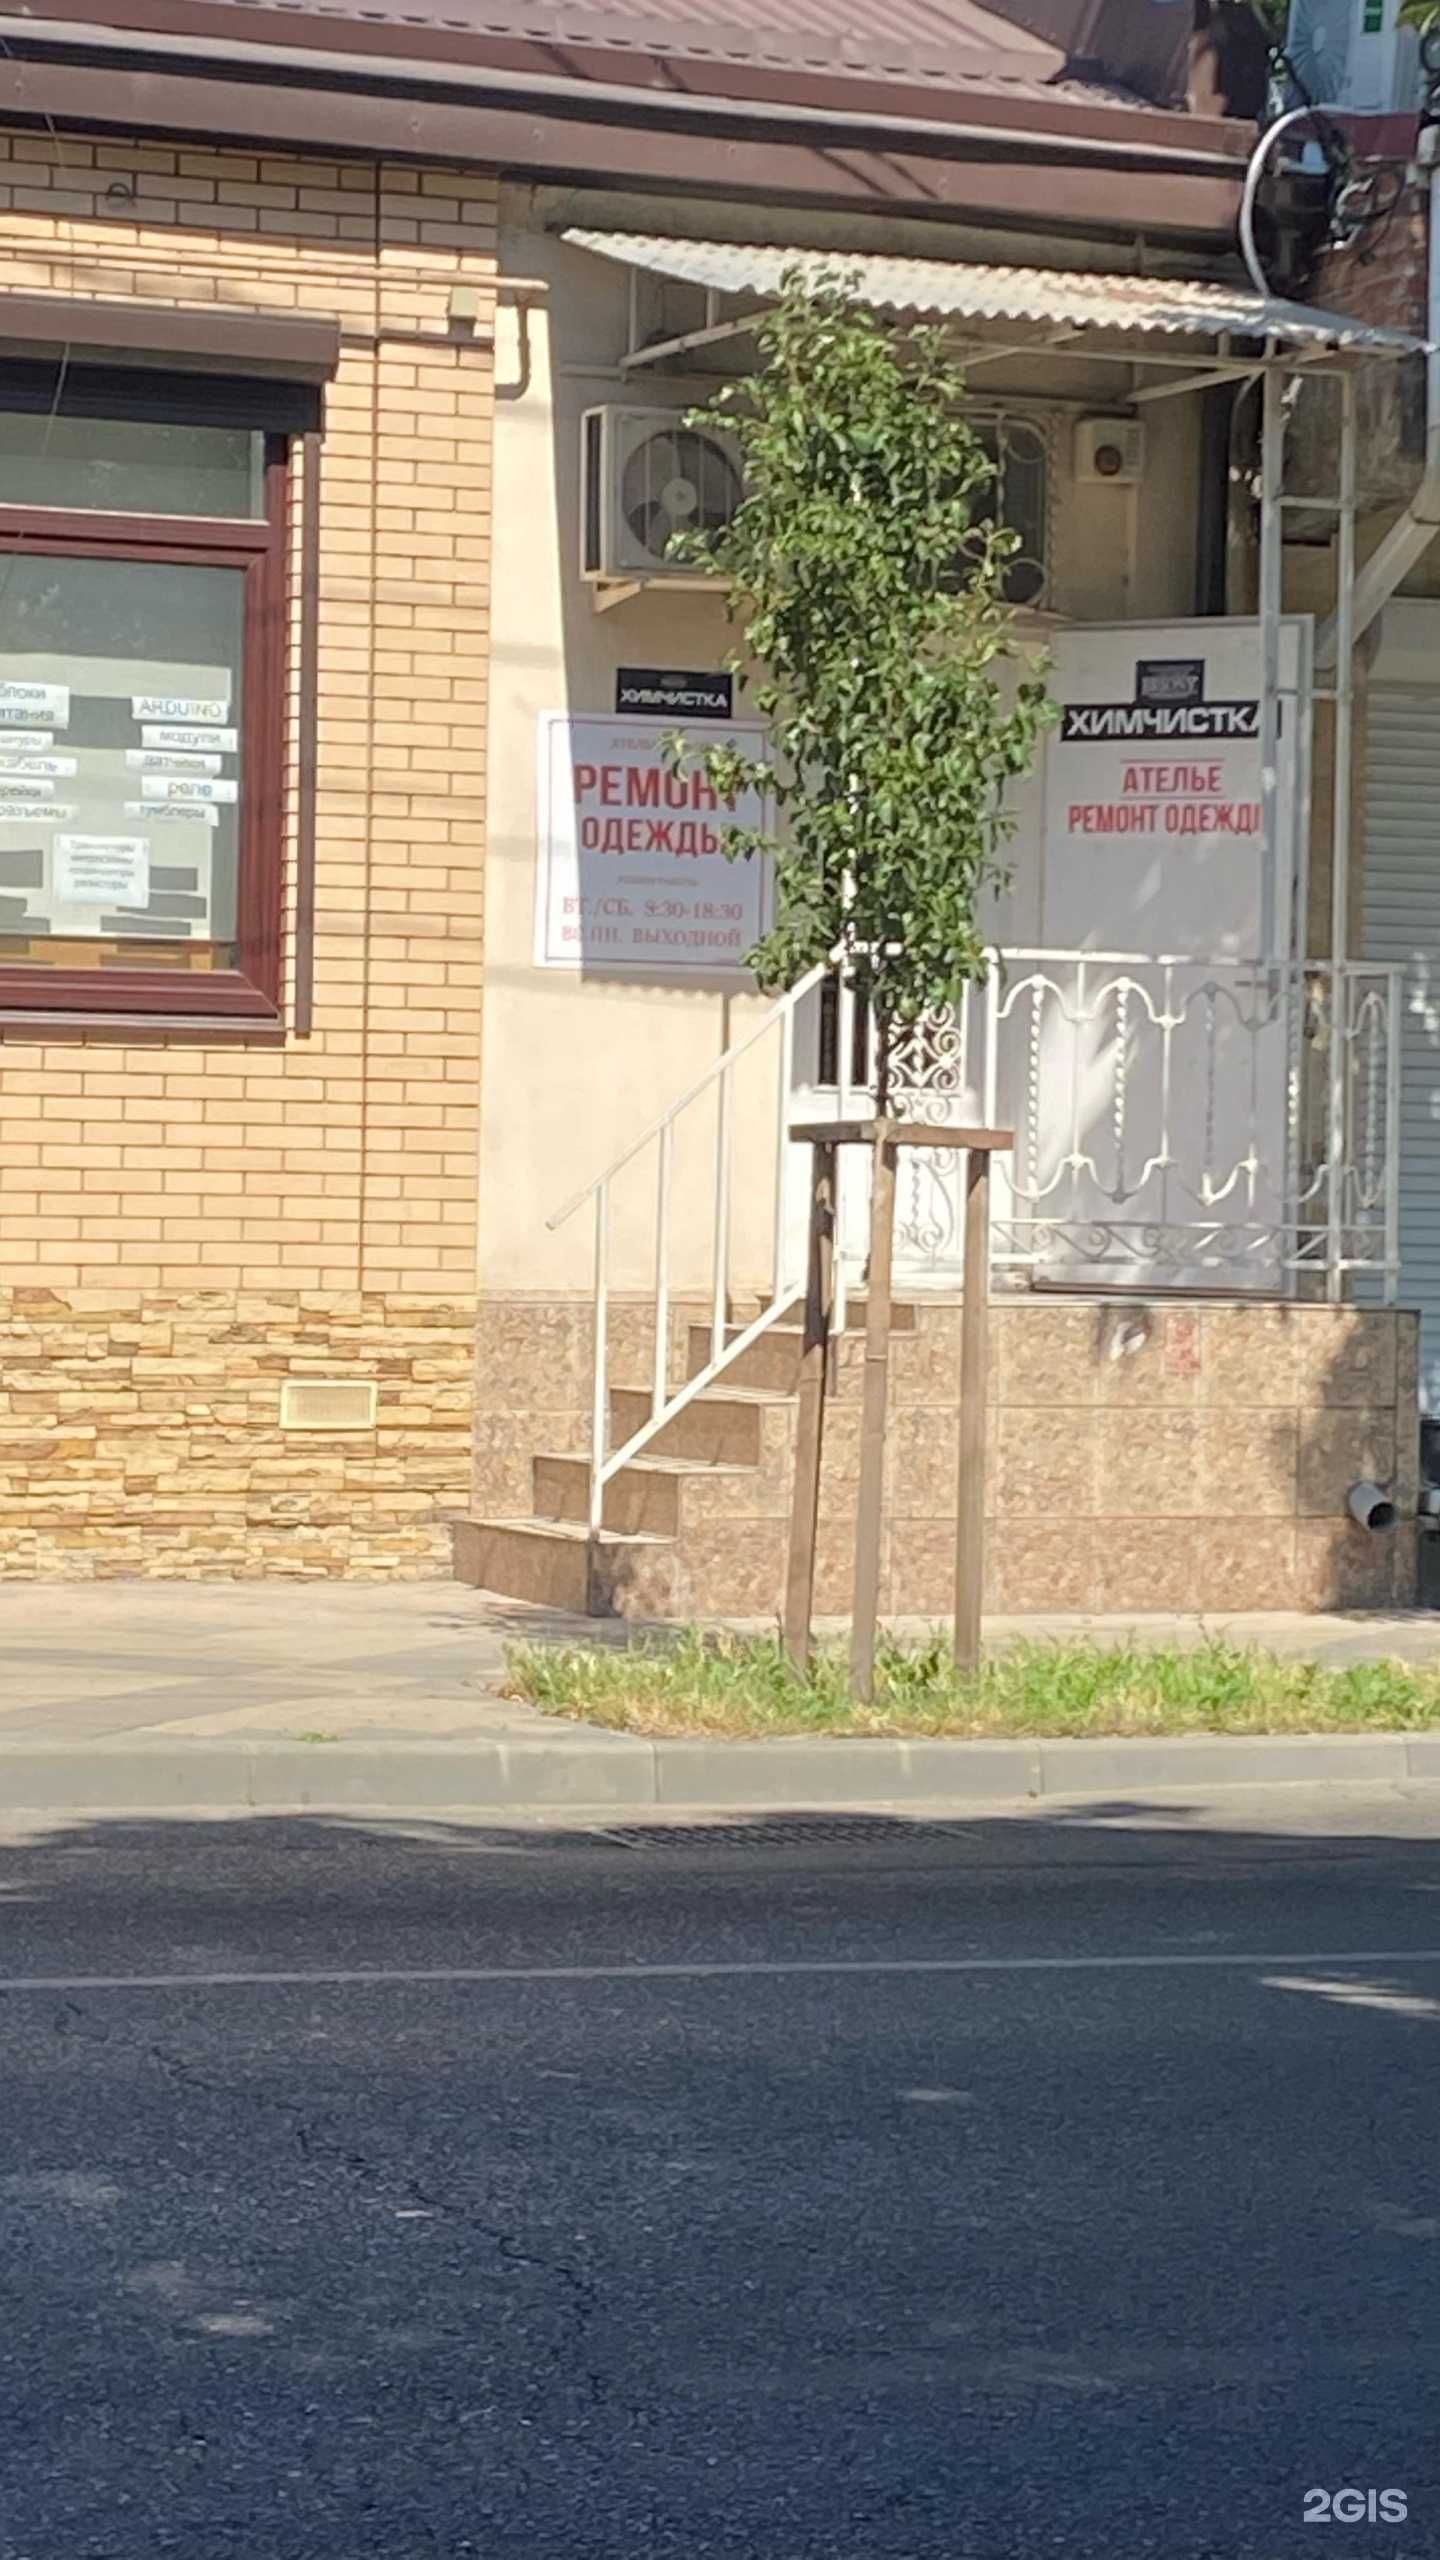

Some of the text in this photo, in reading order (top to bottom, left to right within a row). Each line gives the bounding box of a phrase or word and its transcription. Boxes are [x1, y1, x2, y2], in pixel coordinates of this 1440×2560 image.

[620, 689, 728, 708] ХИМЧИСТКА
[1123, 766, 1223, 792] АТЕЛЬЕ
[1068, 804, 1158, 834] РЕМОНТ
[632, 928, 742, 949] ВЫХОДНОЙ
